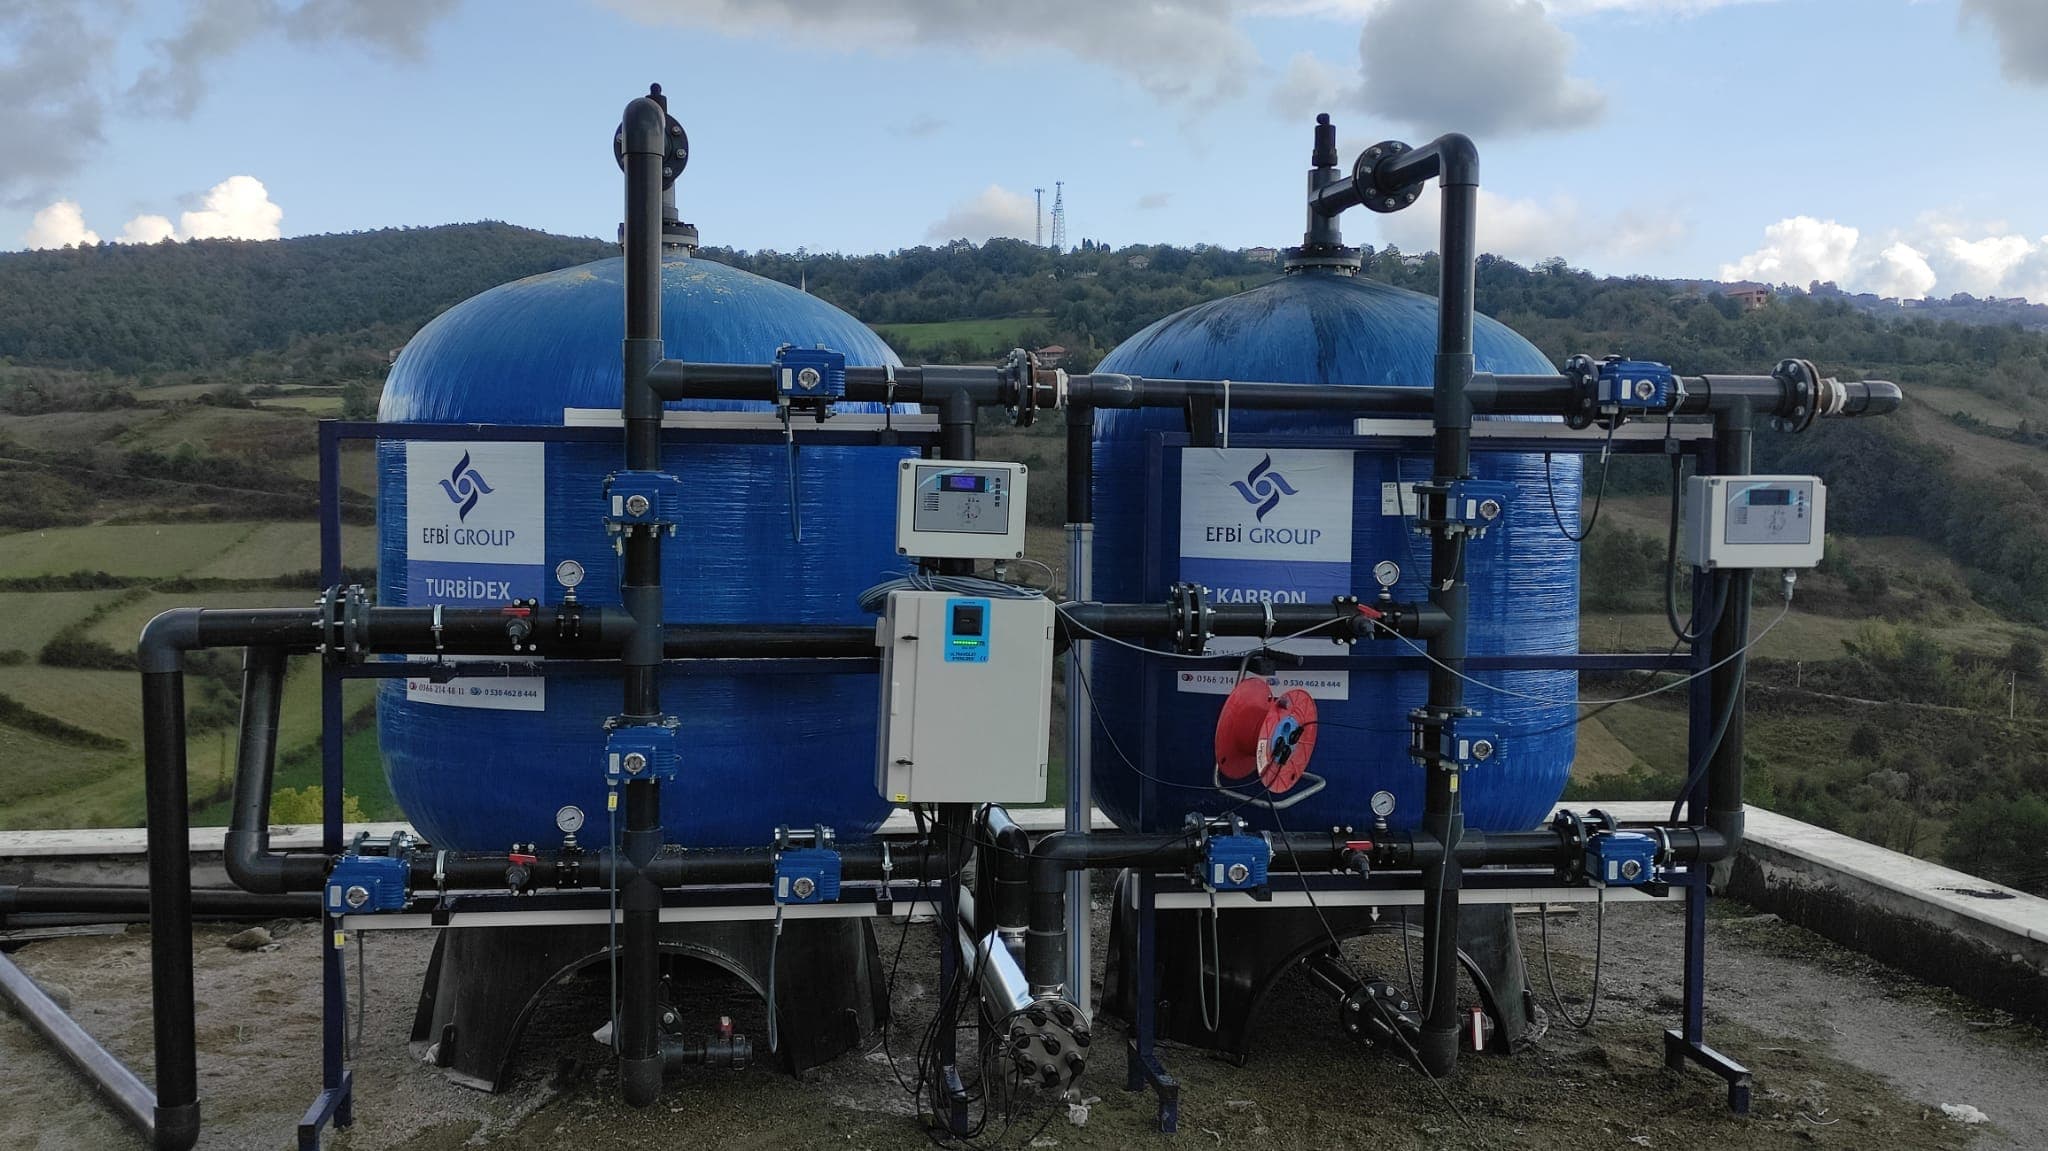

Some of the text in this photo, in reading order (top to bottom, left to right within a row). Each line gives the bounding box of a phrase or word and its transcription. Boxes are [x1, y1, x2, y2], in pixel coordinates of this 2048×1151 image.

[423, 524, 515, 546] EFBİ GROUP
[1206, 523, 1321, 545] EFBİ GROUP
[426, 576, 510, 600] TURBİDEX
[1216, 588, 1307, 604] KARBON
[1326, 681, 1341, 689] 444
